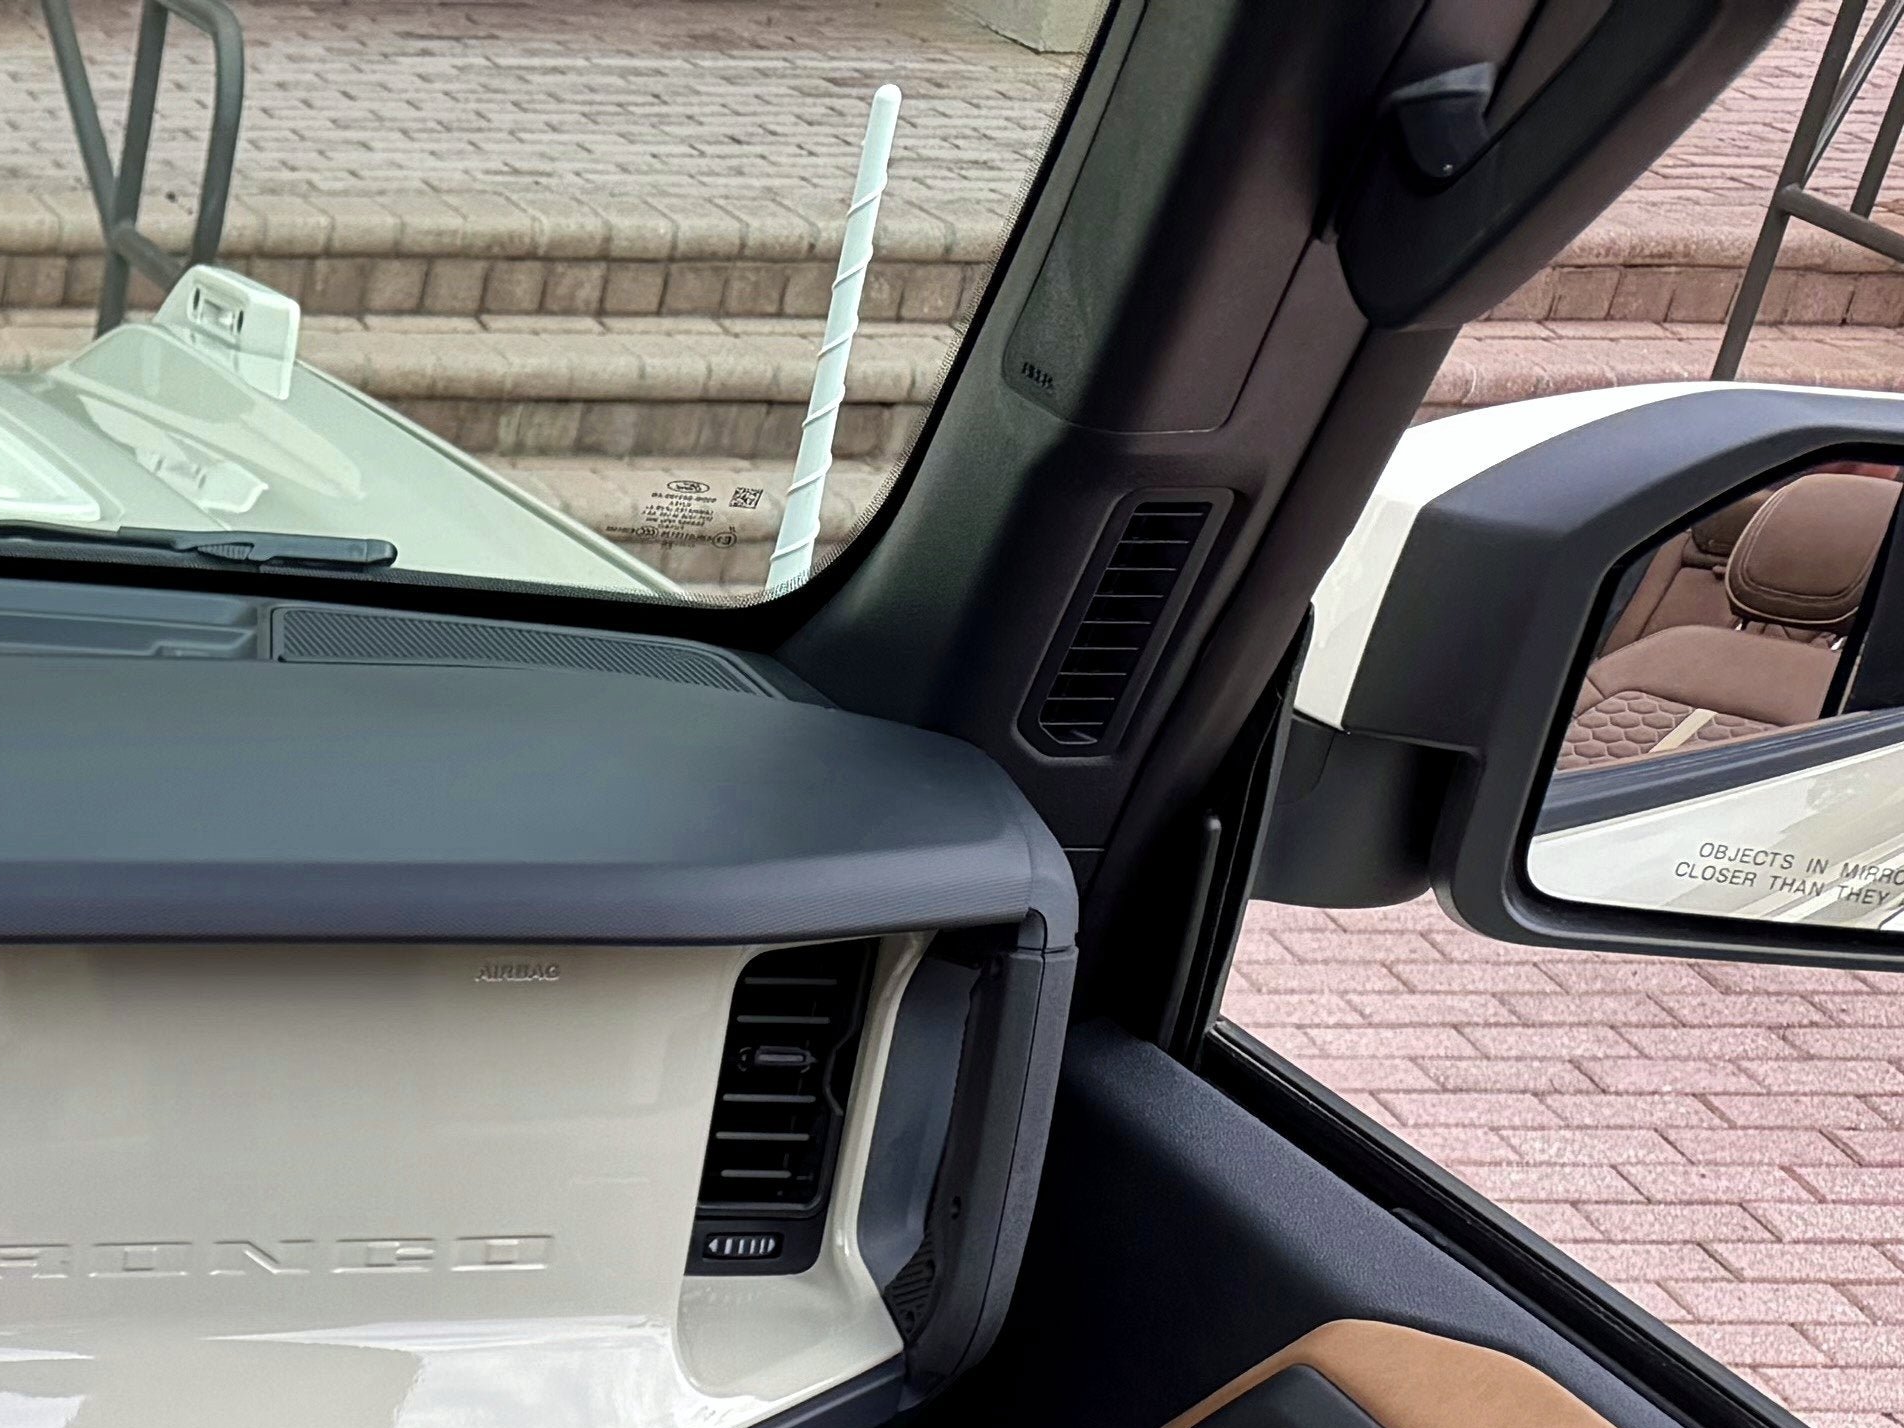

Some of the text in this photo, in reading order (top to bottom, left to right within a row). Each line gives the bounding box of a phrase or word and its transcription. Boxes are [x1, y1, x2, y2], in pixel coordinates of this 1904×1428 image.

[1699, 842, 1795, 870] OBJECTS
[1806, 858, 1830, 874] IN
[1674, 862, 1891, 906] CLOSER THAN THEY
[474, 964, 561, 982] AIRBAG
